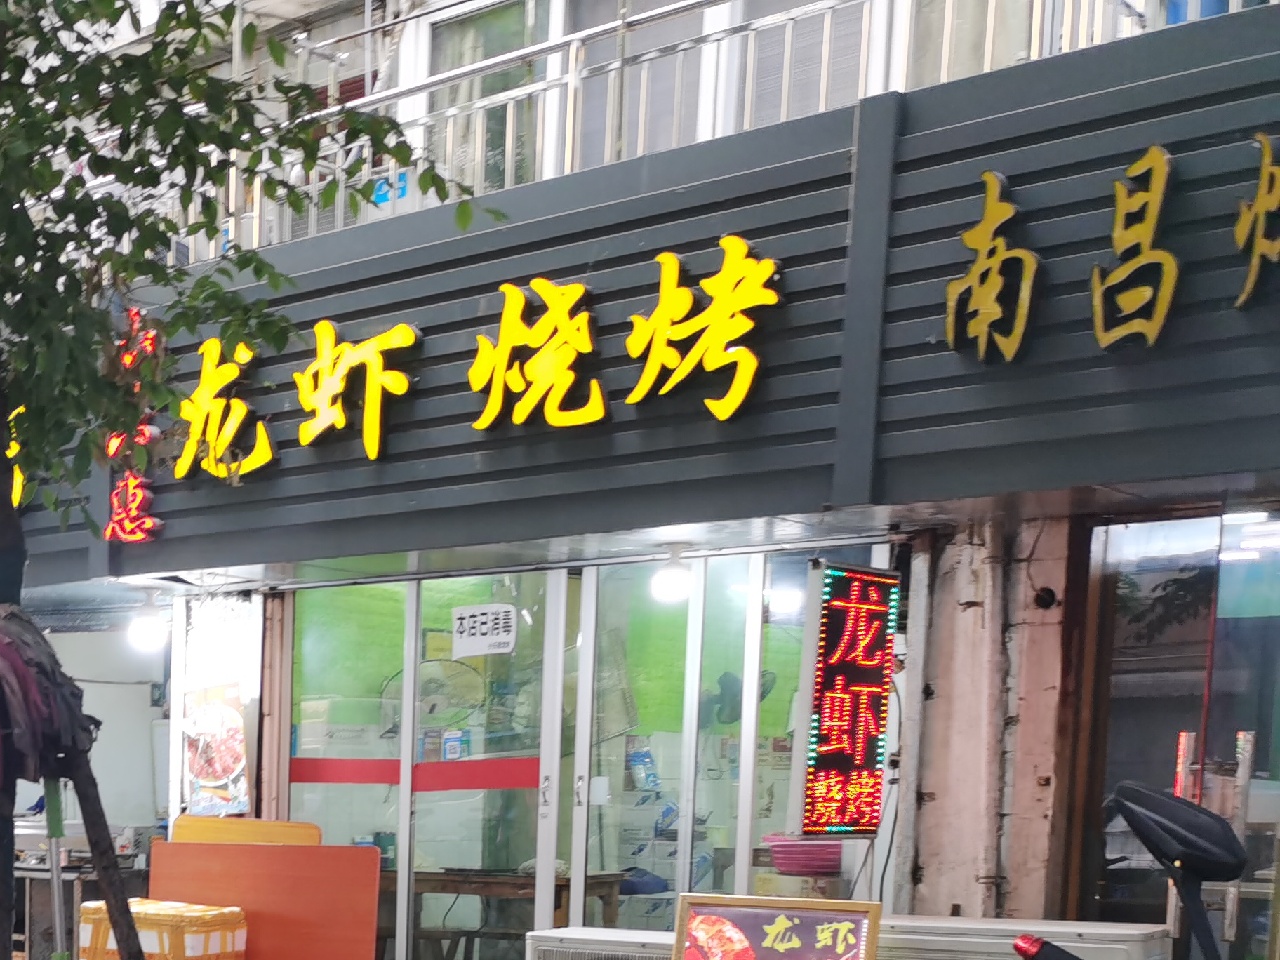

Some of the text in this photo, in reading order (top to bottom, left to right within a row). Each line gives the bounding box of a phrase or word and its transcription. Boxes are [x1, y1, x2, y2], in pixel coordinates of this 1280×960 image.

[173, 235, 780, 482] 龙虾烧烤
[456, 610, 513, 638] 本店已消毒
[817, 579, 889, 766] 龙虾
[761, 914, 856, 954] 龙虾
